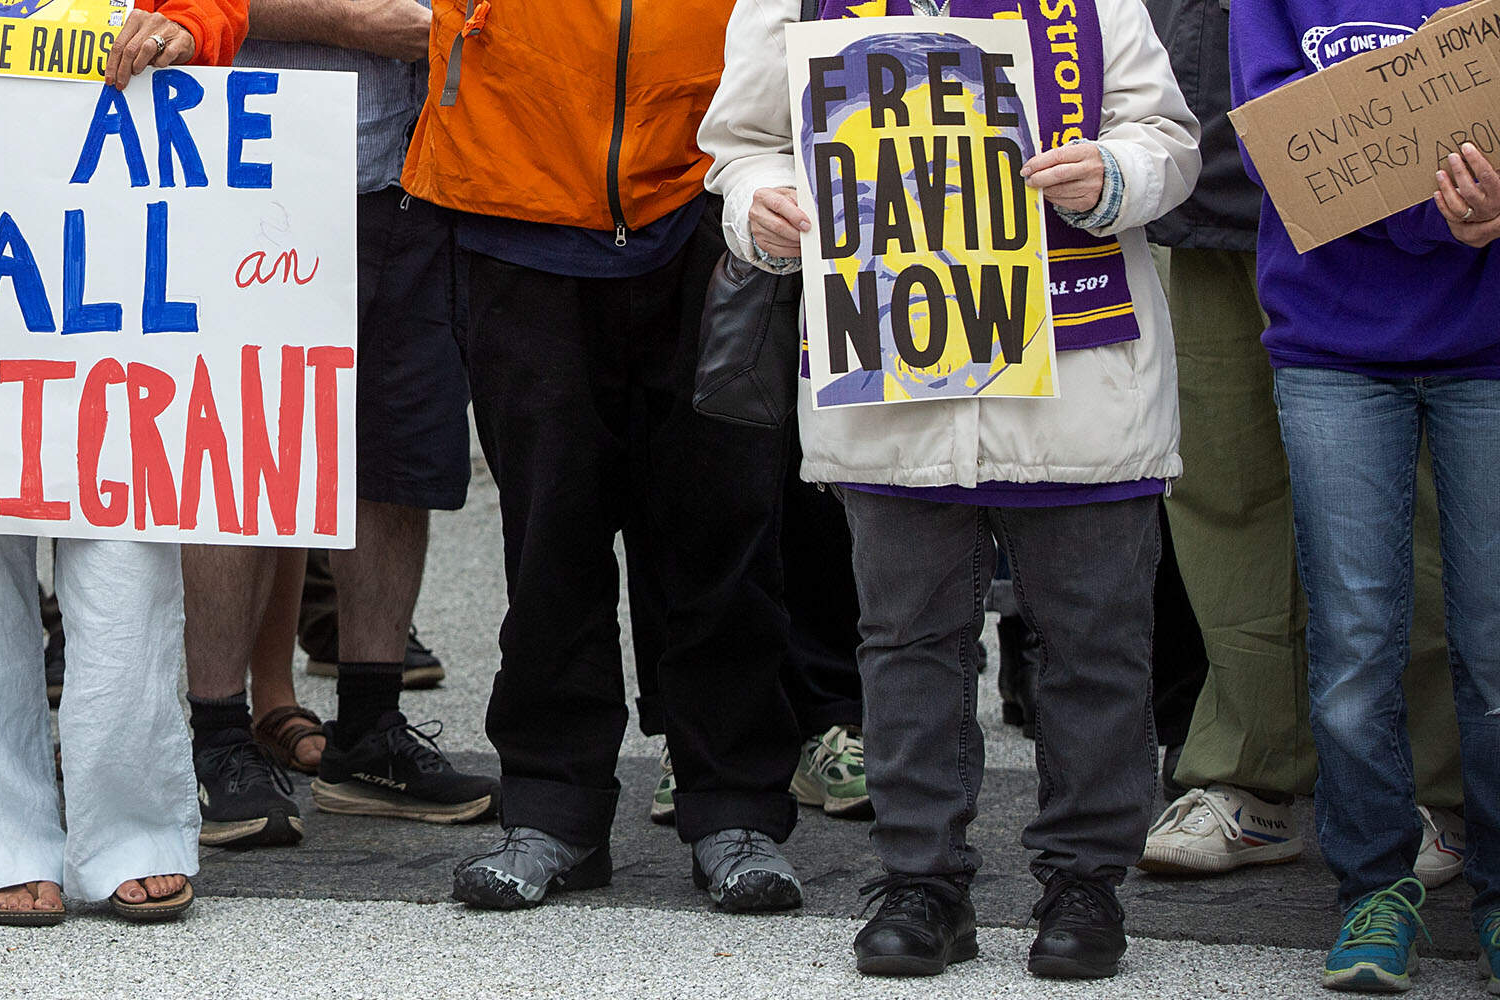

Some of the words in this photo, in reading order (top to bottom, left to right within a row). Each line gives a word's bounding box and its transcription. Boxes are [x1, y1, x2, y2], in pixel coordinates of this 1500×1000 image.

[30, 26, 115, 77] RAIDS
[1324, 37, 1348, 58] NOT
[1350, 34, 1377, 53] ONE
[1365, 47, 1428, 83] TOM
[69, 68, 280, 189] ARE
[808, 52, 1019, 133] FREE
[1287, 98, 1393, 162] GIVING
[1402, 60, 1491, 113] LITTLE
[814, 135, 1029, 260] DAVID
[1305, 127, 1421, 205] ENERGY
[235, 250, 319, 289] an
[1074, 274, 1109, 293] 509
[823, 263, 1029, 375] NOW
